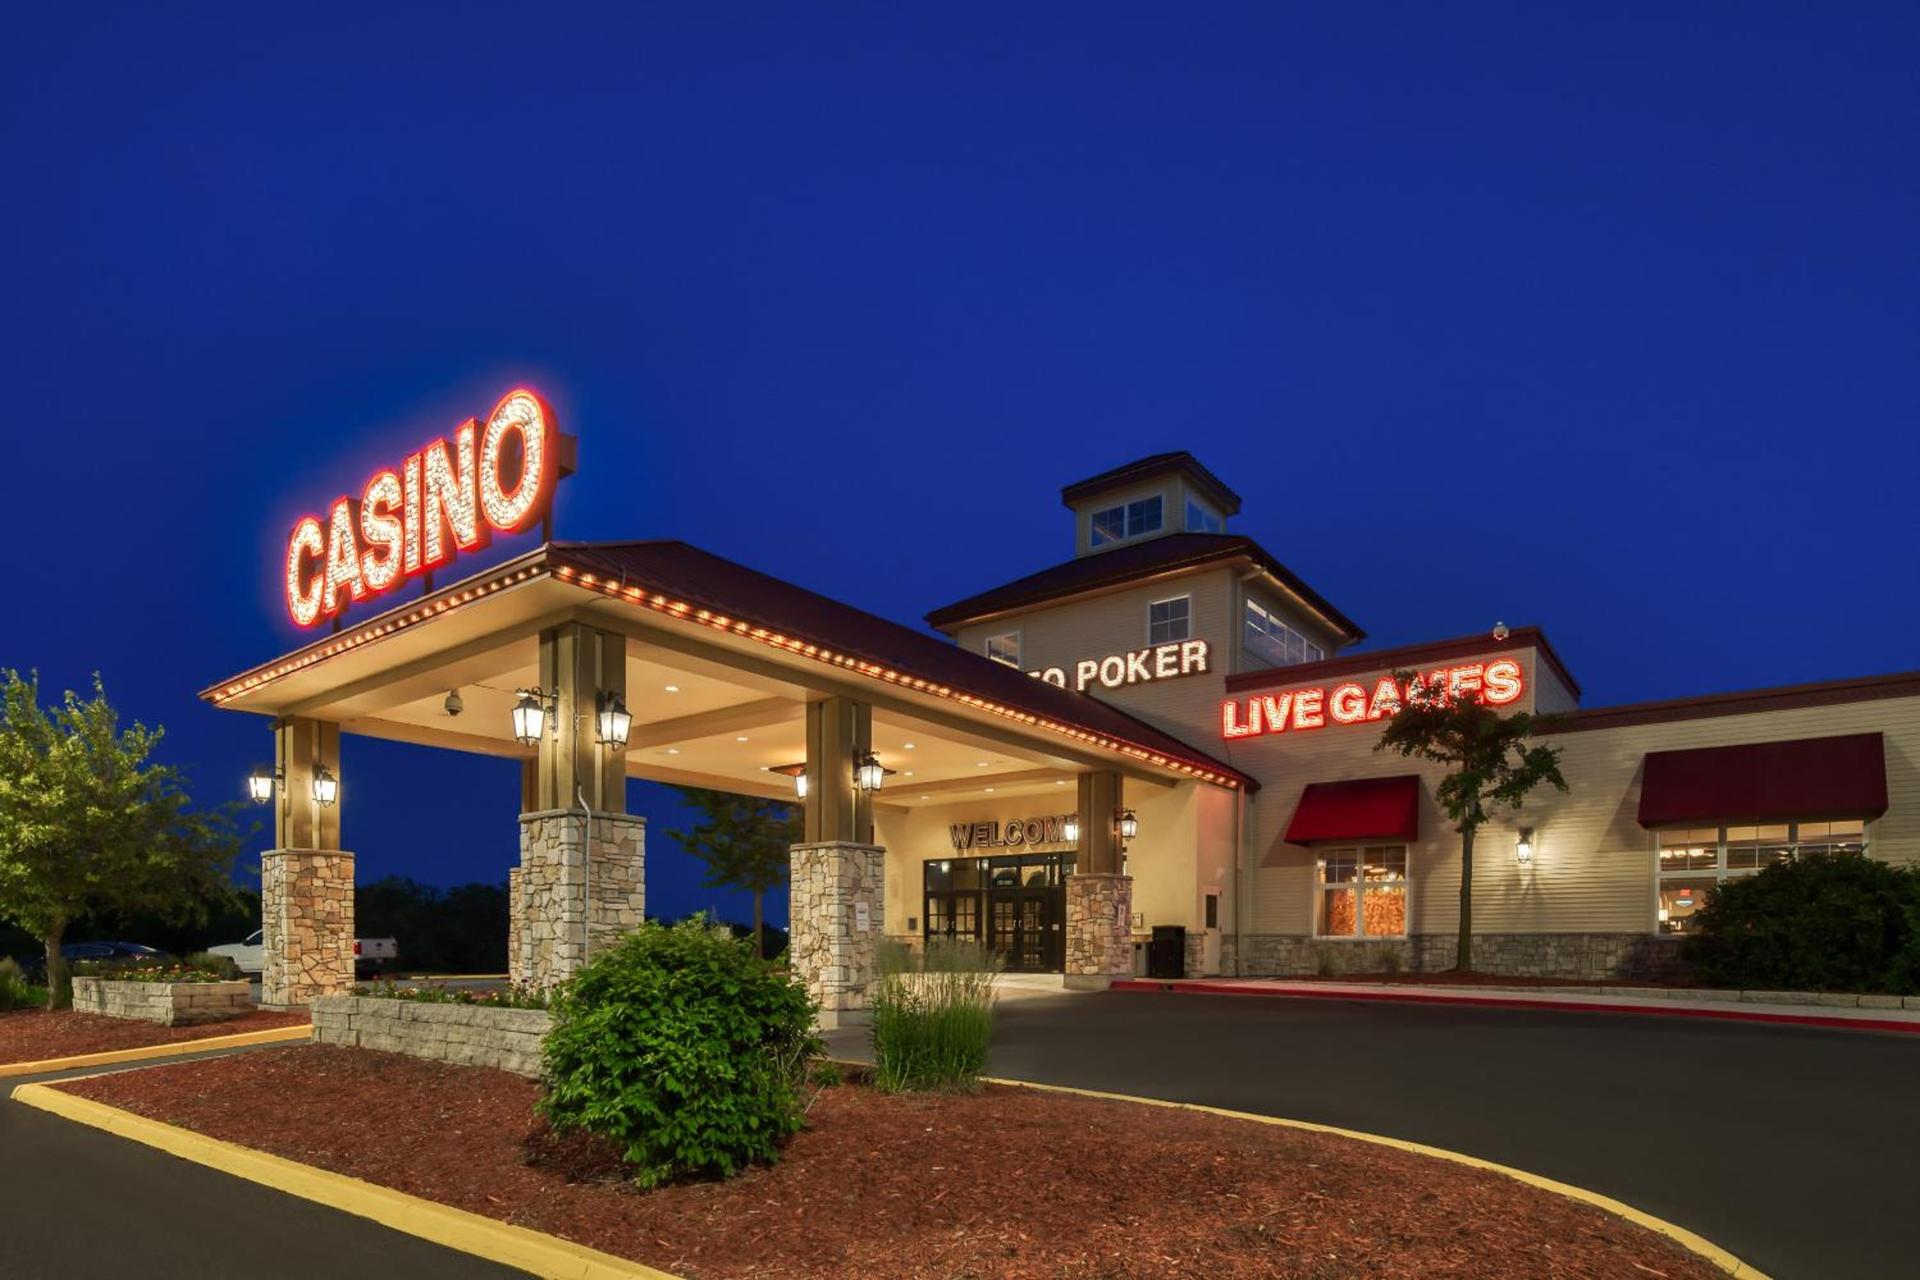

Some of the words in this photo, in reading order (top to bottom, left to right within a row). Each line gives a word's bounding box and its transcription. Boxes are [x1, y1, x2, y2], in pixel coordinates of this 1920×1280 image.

[287, 388, 550, 627] CASINO
[1077, 640, 1209, 692] POKER
[1221, 688, 1325, 738] LIVE
